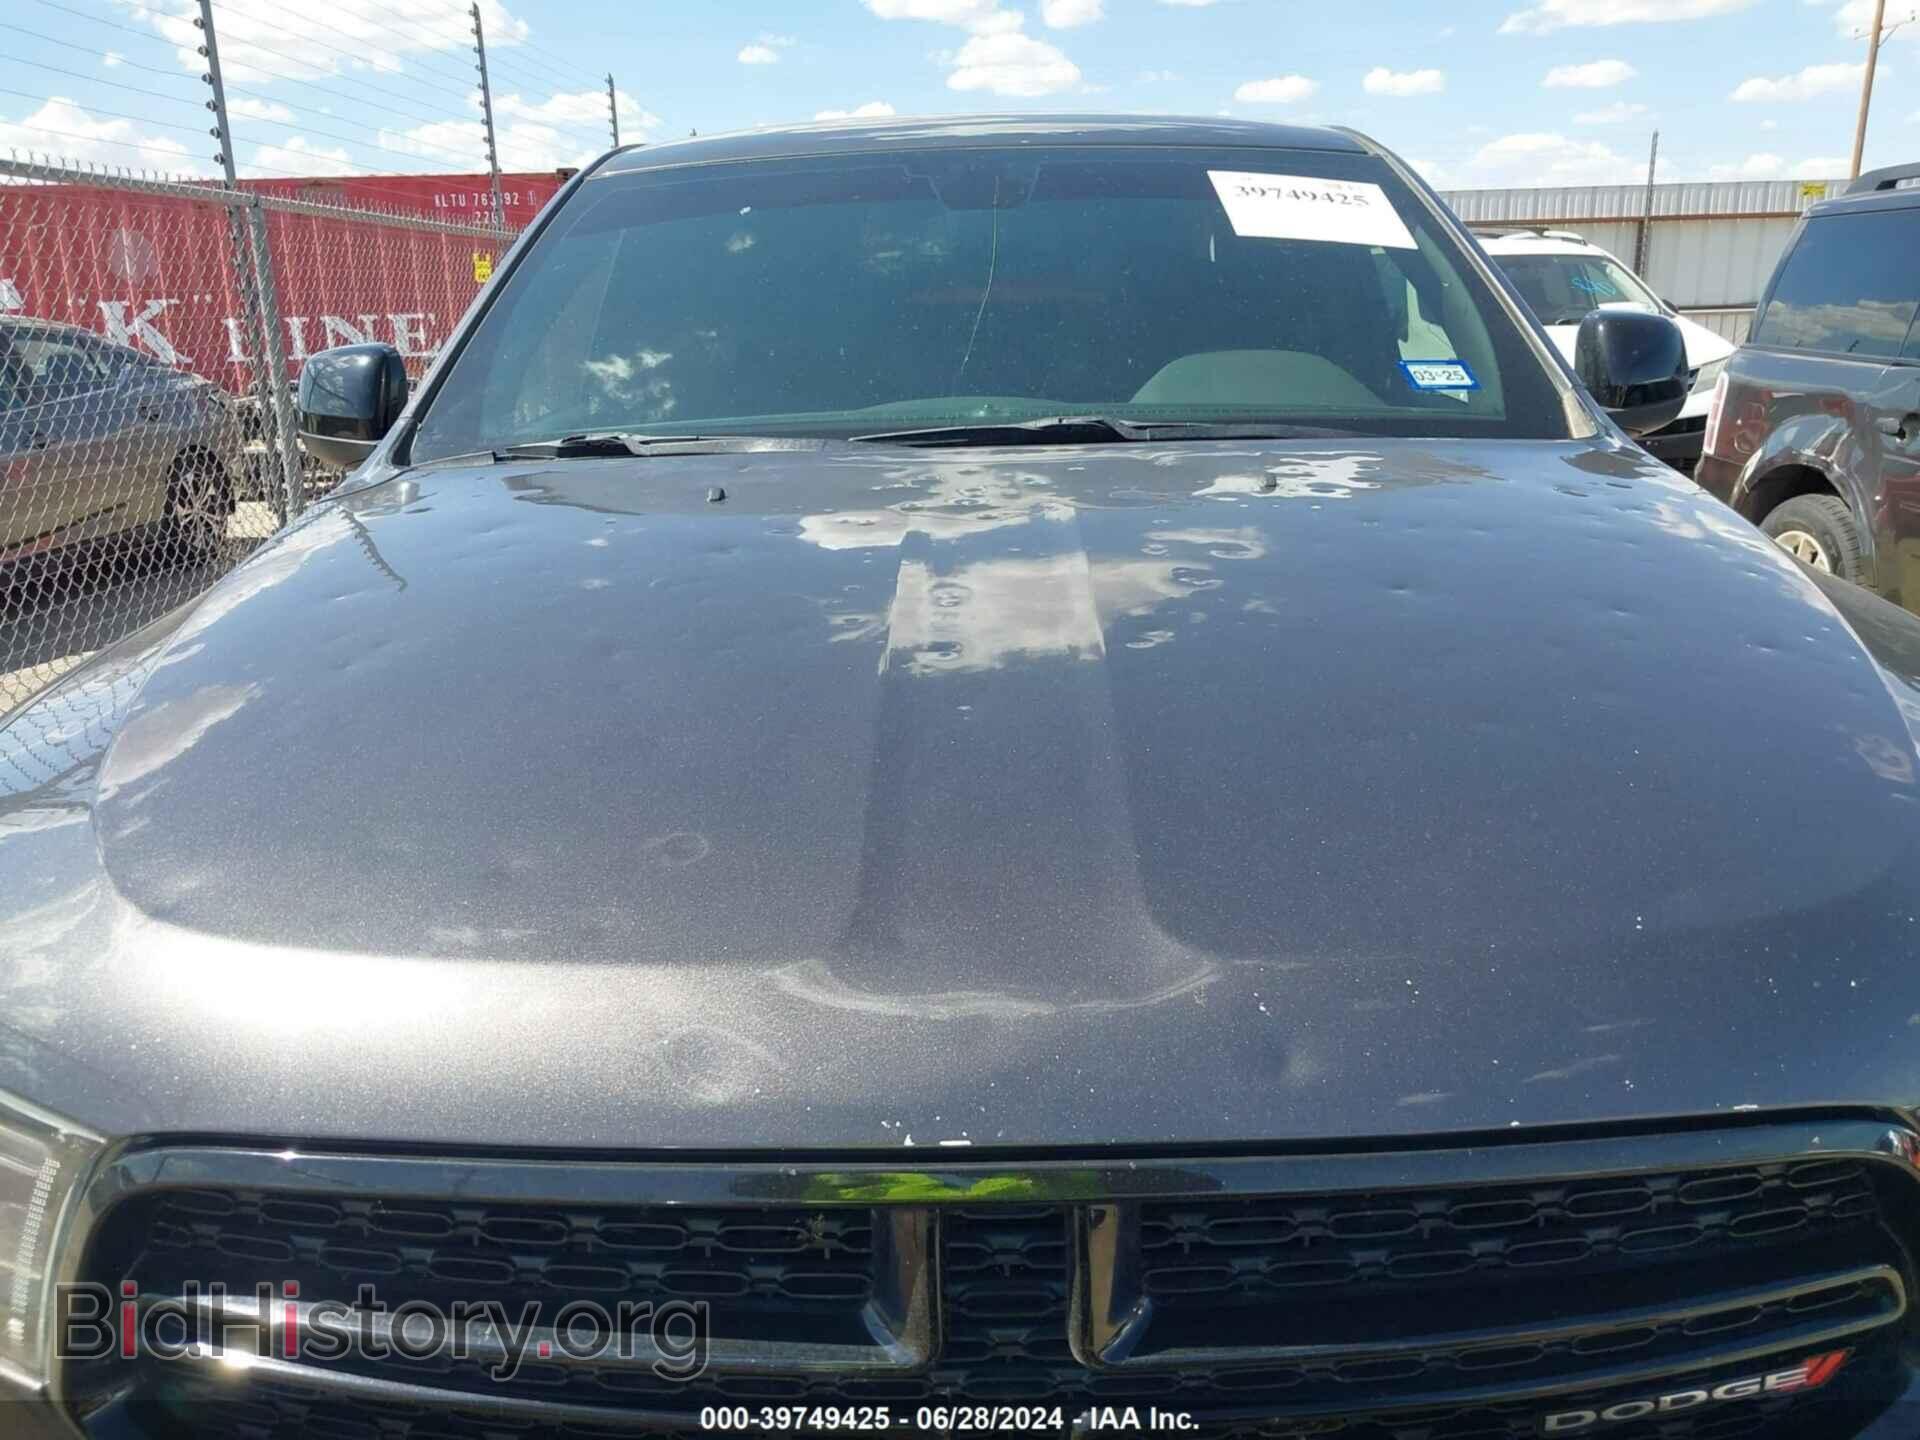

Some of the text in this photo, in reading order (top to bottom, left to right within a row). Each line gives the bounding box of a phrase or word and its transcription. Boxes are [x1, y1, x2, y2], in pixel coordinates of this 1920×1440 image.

[1235, 183, 1370, 207] 39749425
[1413, 369, 1466, 381] 03-25
[1543, 1367, 1809, 1432] DODGE
